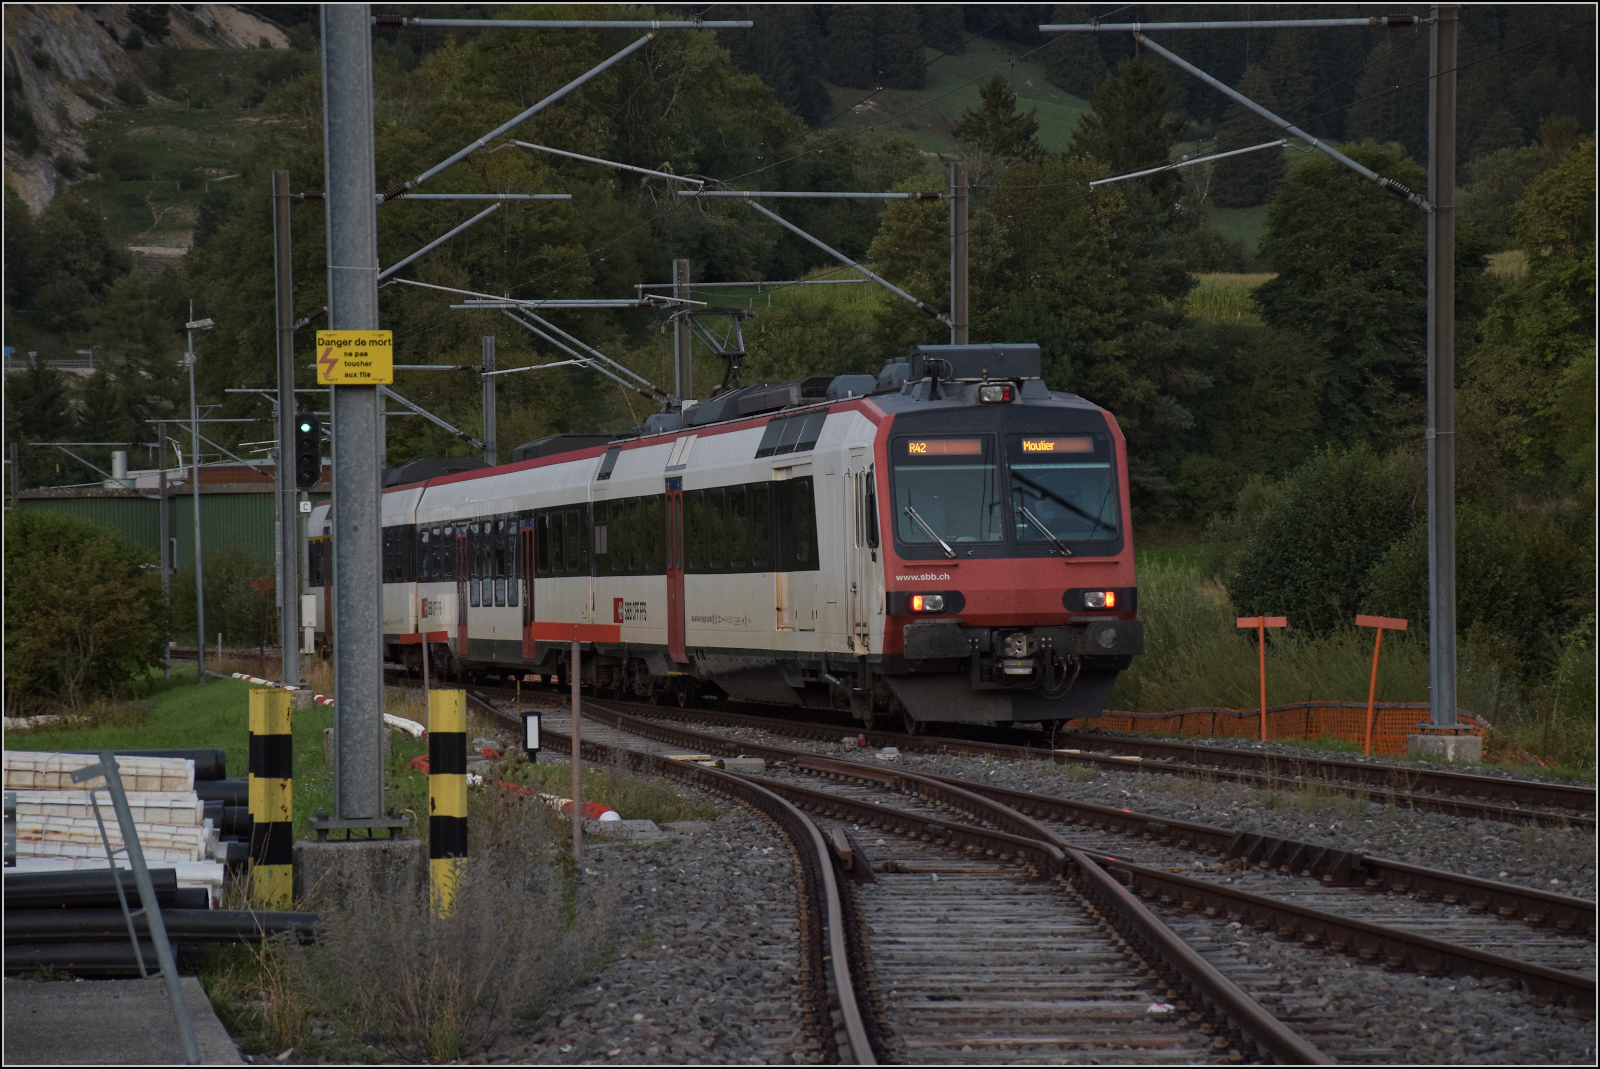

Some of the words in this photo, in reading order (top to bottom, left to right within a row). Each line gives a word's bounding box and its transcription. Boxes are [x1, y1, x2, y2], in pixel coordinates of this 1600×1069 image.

[317, 338, 352, 348] Danger
[354, 338, 367, 346] de
[369, 338, 392, 346] mort
[908, 442, 927, 453] R42
[1023, 440, 1055, 451] Moutier
[303, 502, 308, 511] C
[895, 573, 950, 581] www.sbb.ch
